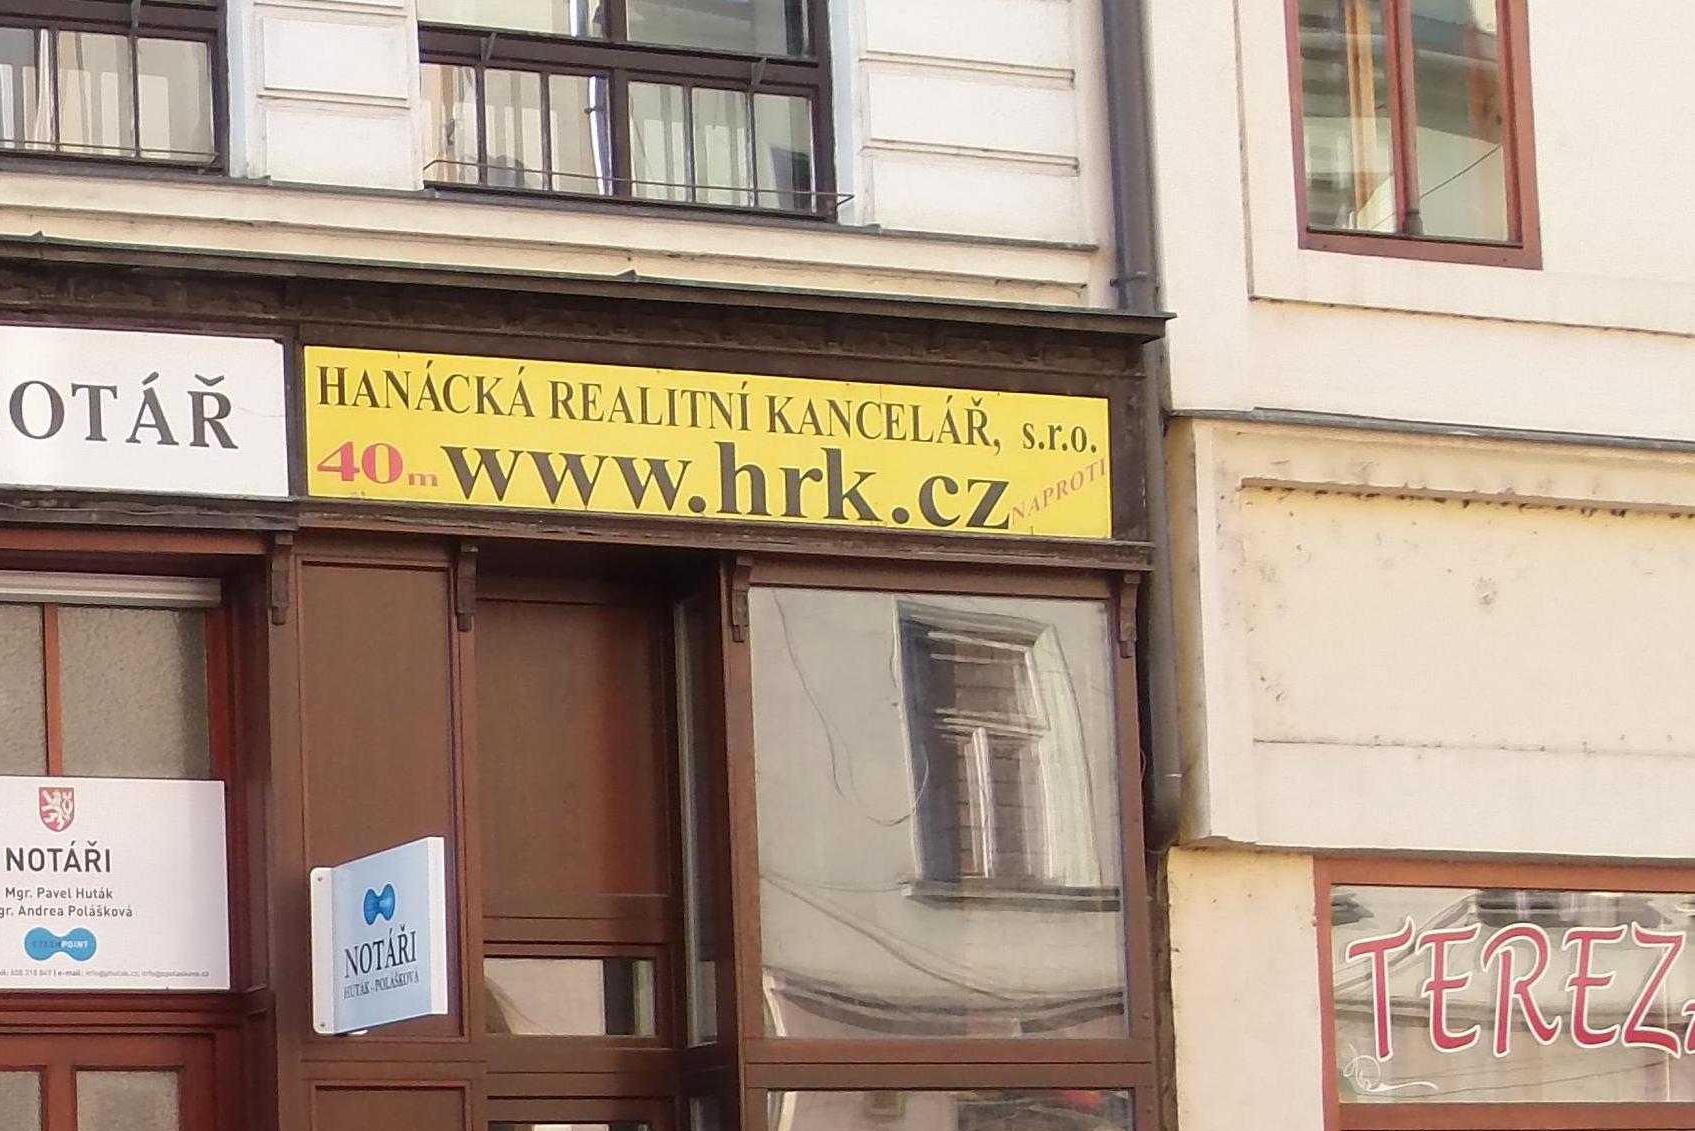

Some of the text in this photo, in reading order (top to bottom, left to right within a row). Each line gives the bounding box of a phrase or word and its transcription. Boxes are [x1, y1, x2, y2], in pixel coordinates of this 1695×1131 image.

[316, 360, 1098, 456] HANÁCKÁ REALITNÍ KANCELÁŘ, s.r.o.
[440, 440, 1012, 530] www.hrk.cz
[1010, 456, 1108, 529] NAPROTI
[5, 840, 111, 873] NOTÁŘI
[5, 886, 113, 900] Mgr. Pavel Huták
[18, 905, 64, 917] Andrea
[68, 904, 133, 917] Polášková
[60, 939, 89, 949] POINT
[344, 924, 417, 978] NOTÁŘI
